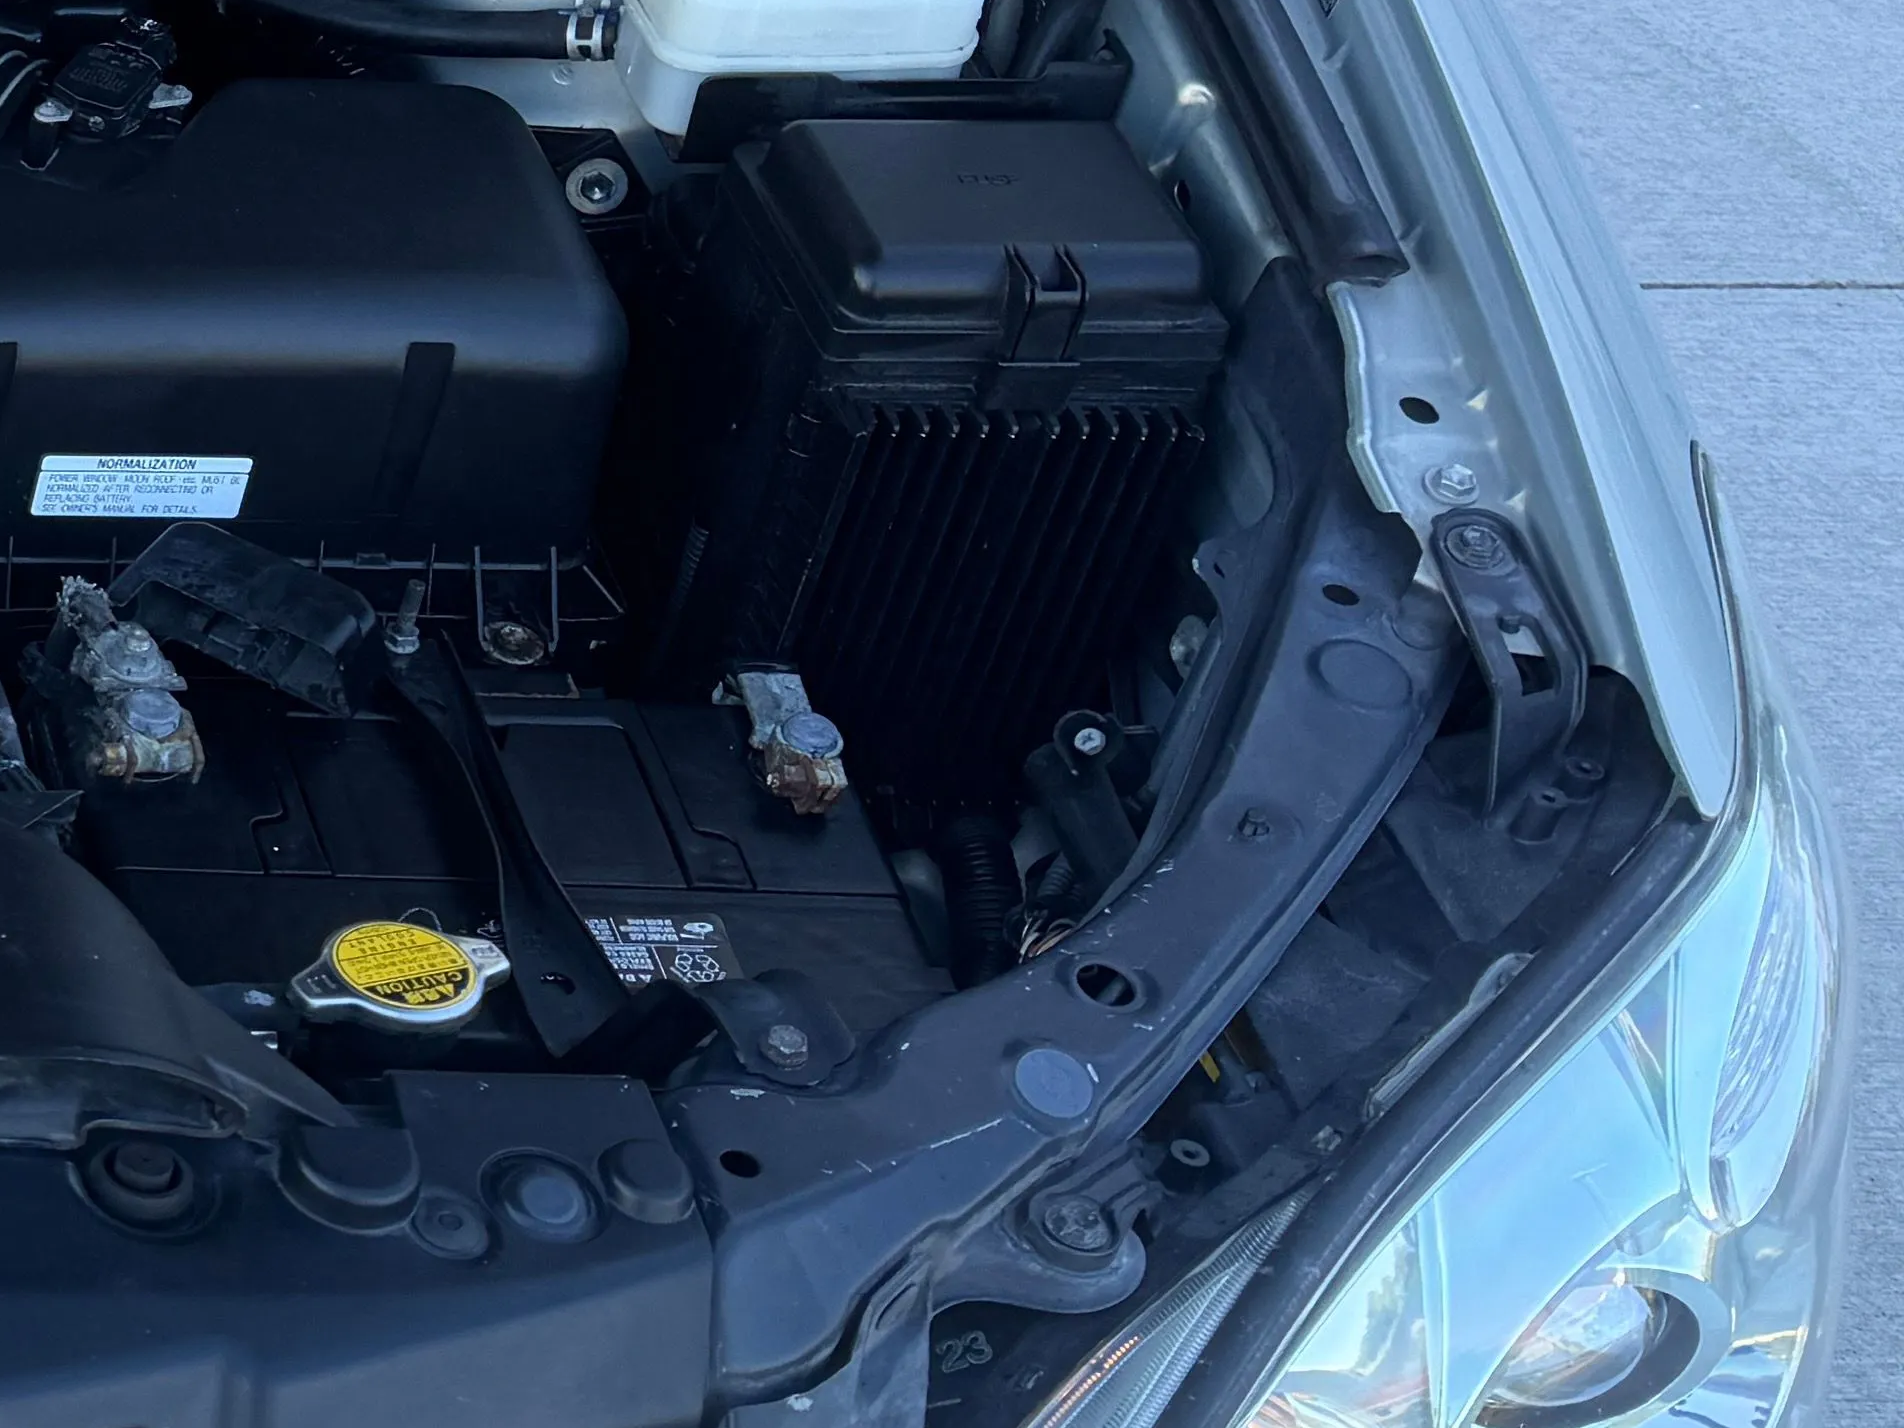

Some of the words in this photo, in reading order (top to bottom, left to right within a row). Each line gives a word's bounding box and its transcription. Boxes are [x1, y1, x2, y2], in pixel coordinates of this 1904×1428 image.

[96, 458, 198, 471] NORMALIZATION
[375, 971, 463, 995] CAUTION
[935, 1330, 993, 1373] 23
